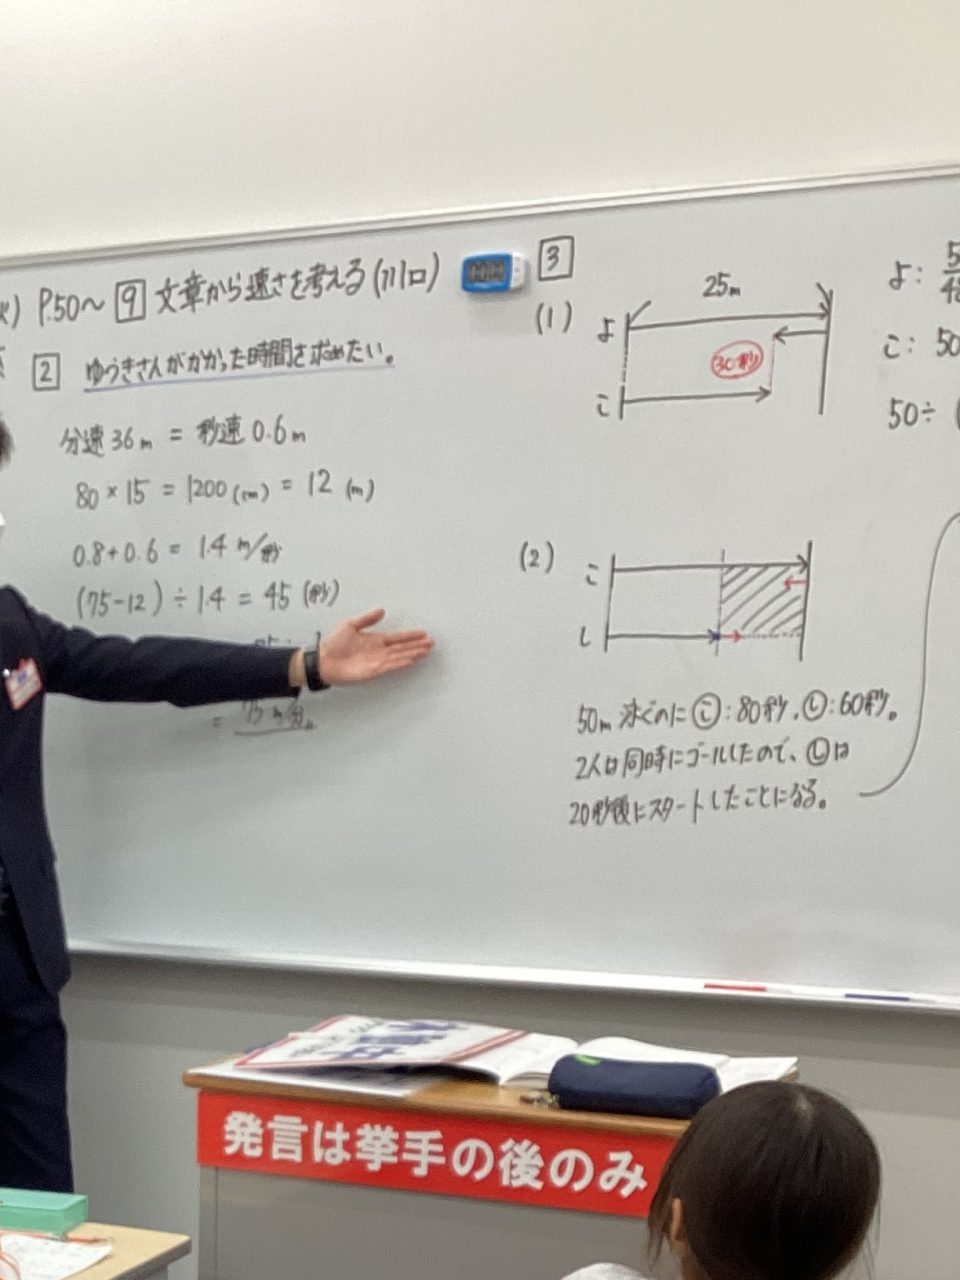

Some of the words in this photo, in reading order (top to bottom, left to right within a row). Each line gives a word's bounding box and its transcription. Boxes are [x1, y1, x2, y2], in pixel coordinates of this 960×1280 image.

[536, 300, 573, 335] (1)
[520, 541, 555, 573] (2)
[223, 1110, 648, 1199] 発言は挙手の後のみ
